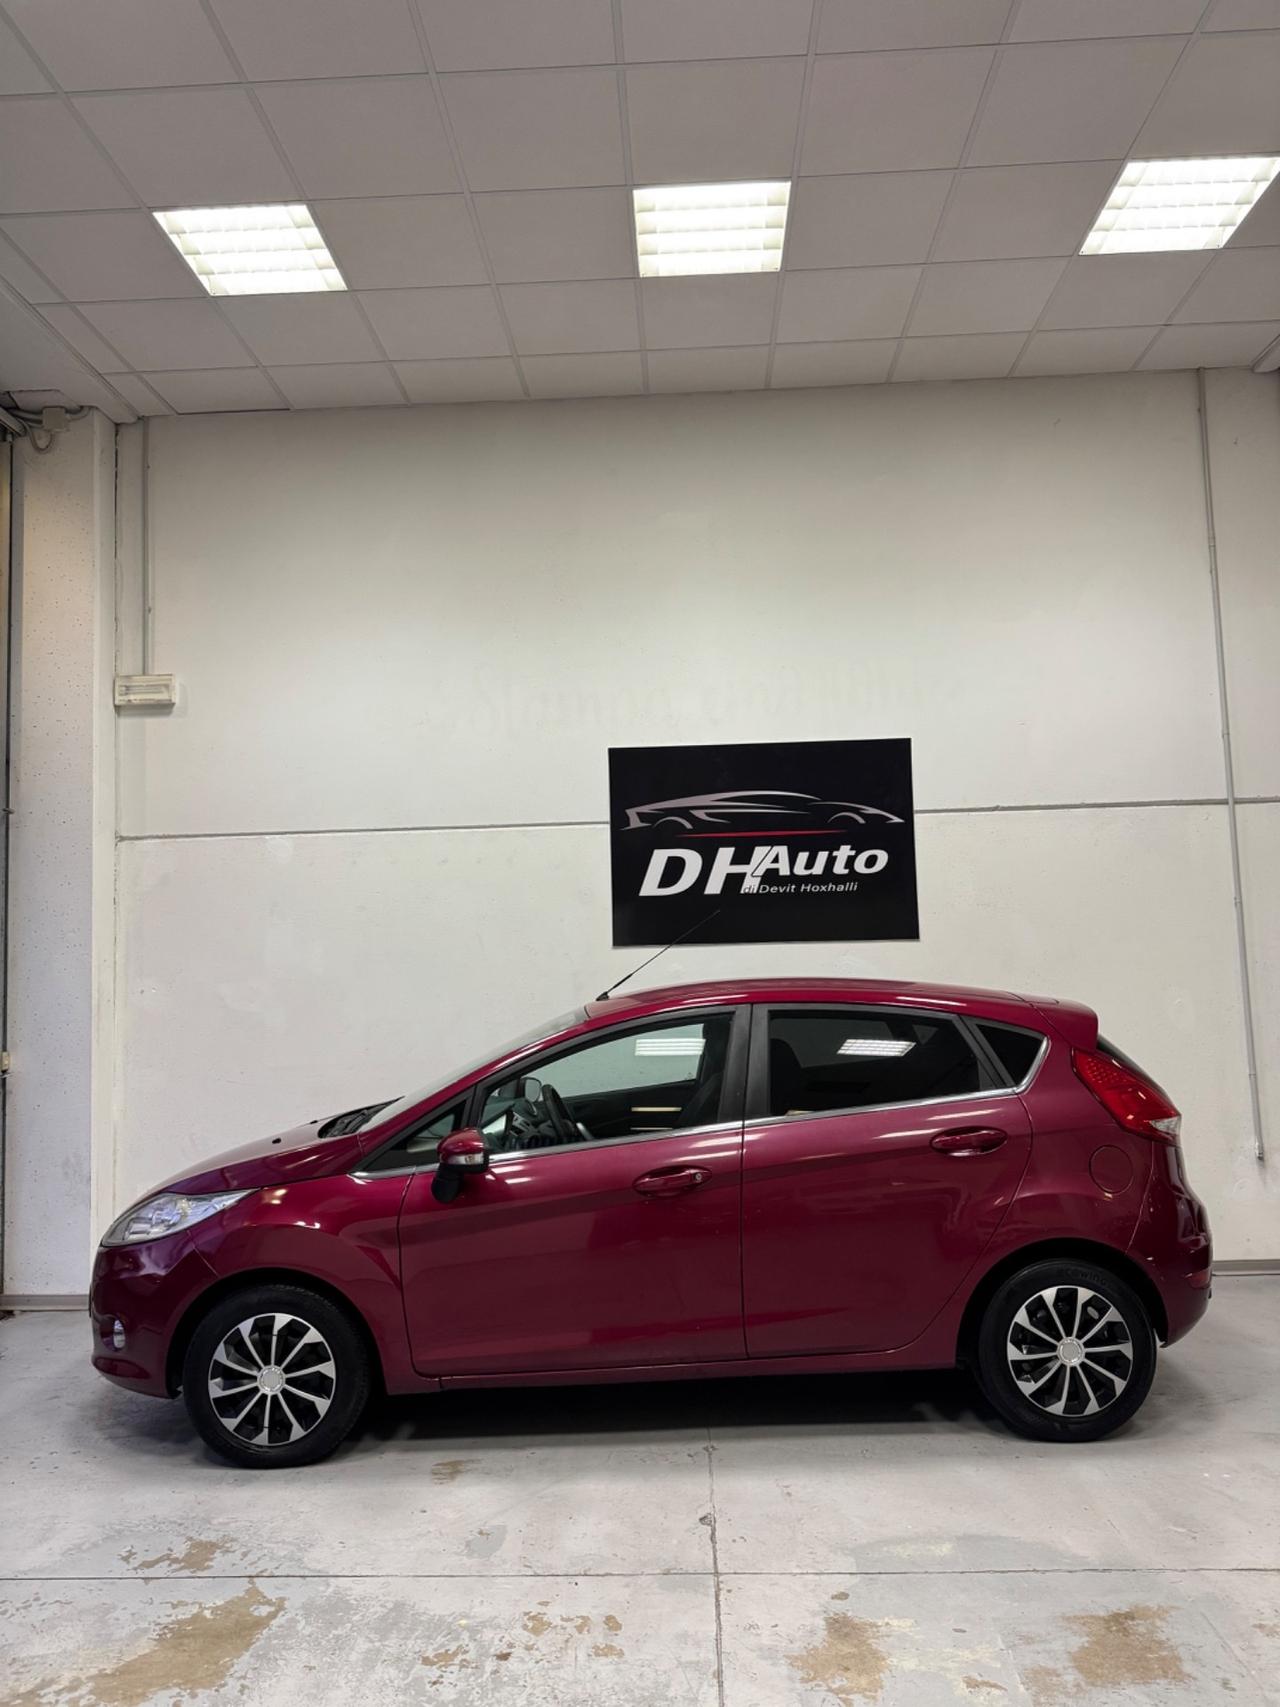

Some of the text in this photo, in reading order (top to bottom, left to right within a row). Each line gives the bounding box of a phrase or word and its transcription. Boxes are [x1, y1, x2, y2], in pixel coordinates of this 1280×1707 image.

[753, 845, 889, 876] Auto
[759, 884, 796, 895] Devit
[800, 882, 859, 893] Hoxhalli
